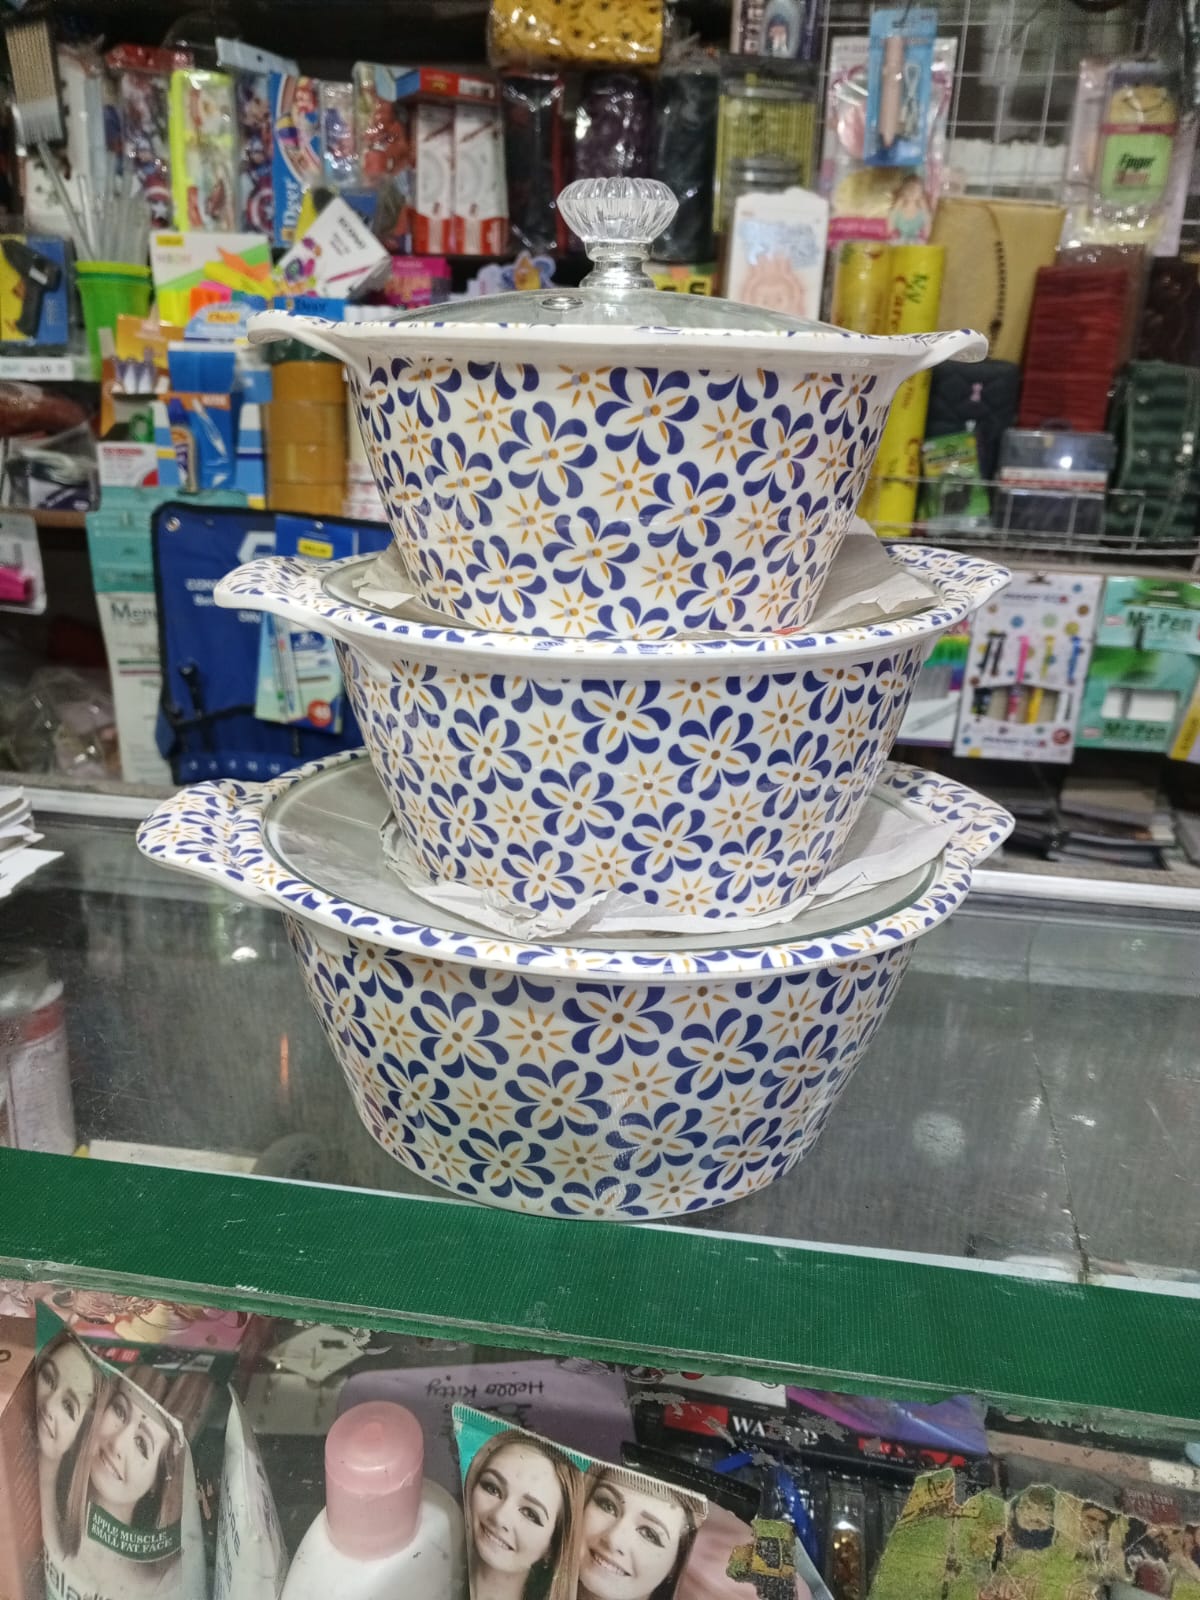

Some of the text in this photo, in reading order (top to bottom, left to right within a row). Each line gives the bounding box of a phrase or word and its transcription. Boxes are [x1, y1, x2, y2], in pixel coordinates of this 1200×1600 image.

[426, 1378, 544, 1399] Hello Kitty
[91, 1523, 172, 1553] SMALL FAT FACE
[93, 1513, 167, 1544] APPLE MUSCLE
